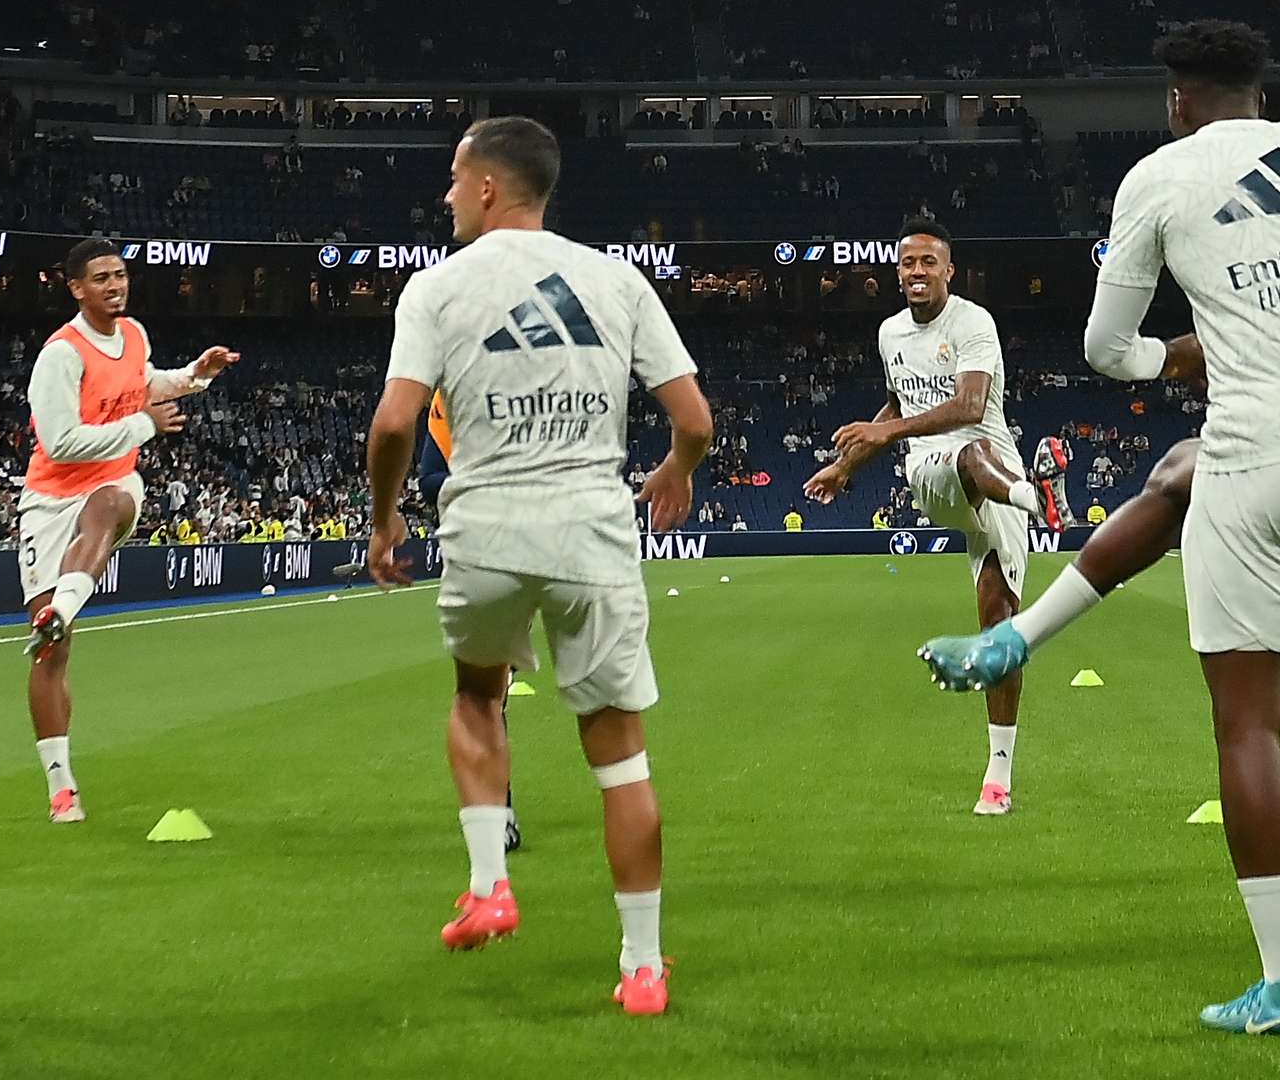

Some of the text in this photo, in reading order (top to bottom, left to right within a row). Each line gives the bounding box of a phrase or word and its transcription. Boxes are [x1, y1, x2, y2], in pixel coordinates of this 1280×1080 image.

[146, 241, 211, 266] BMW
[378, 246, 448, 268] BMW
[607, 244, 675, 266] BMW
[833, 241, 899, 264] BMW
[486, 387, 608, 419] Emirates
[507, 419, 589, 444] FLY BETTER
[639, 534, 707, 560] MW
[194, 547, 223, 587] BMW
[285, 544, 311, 580] BMW
